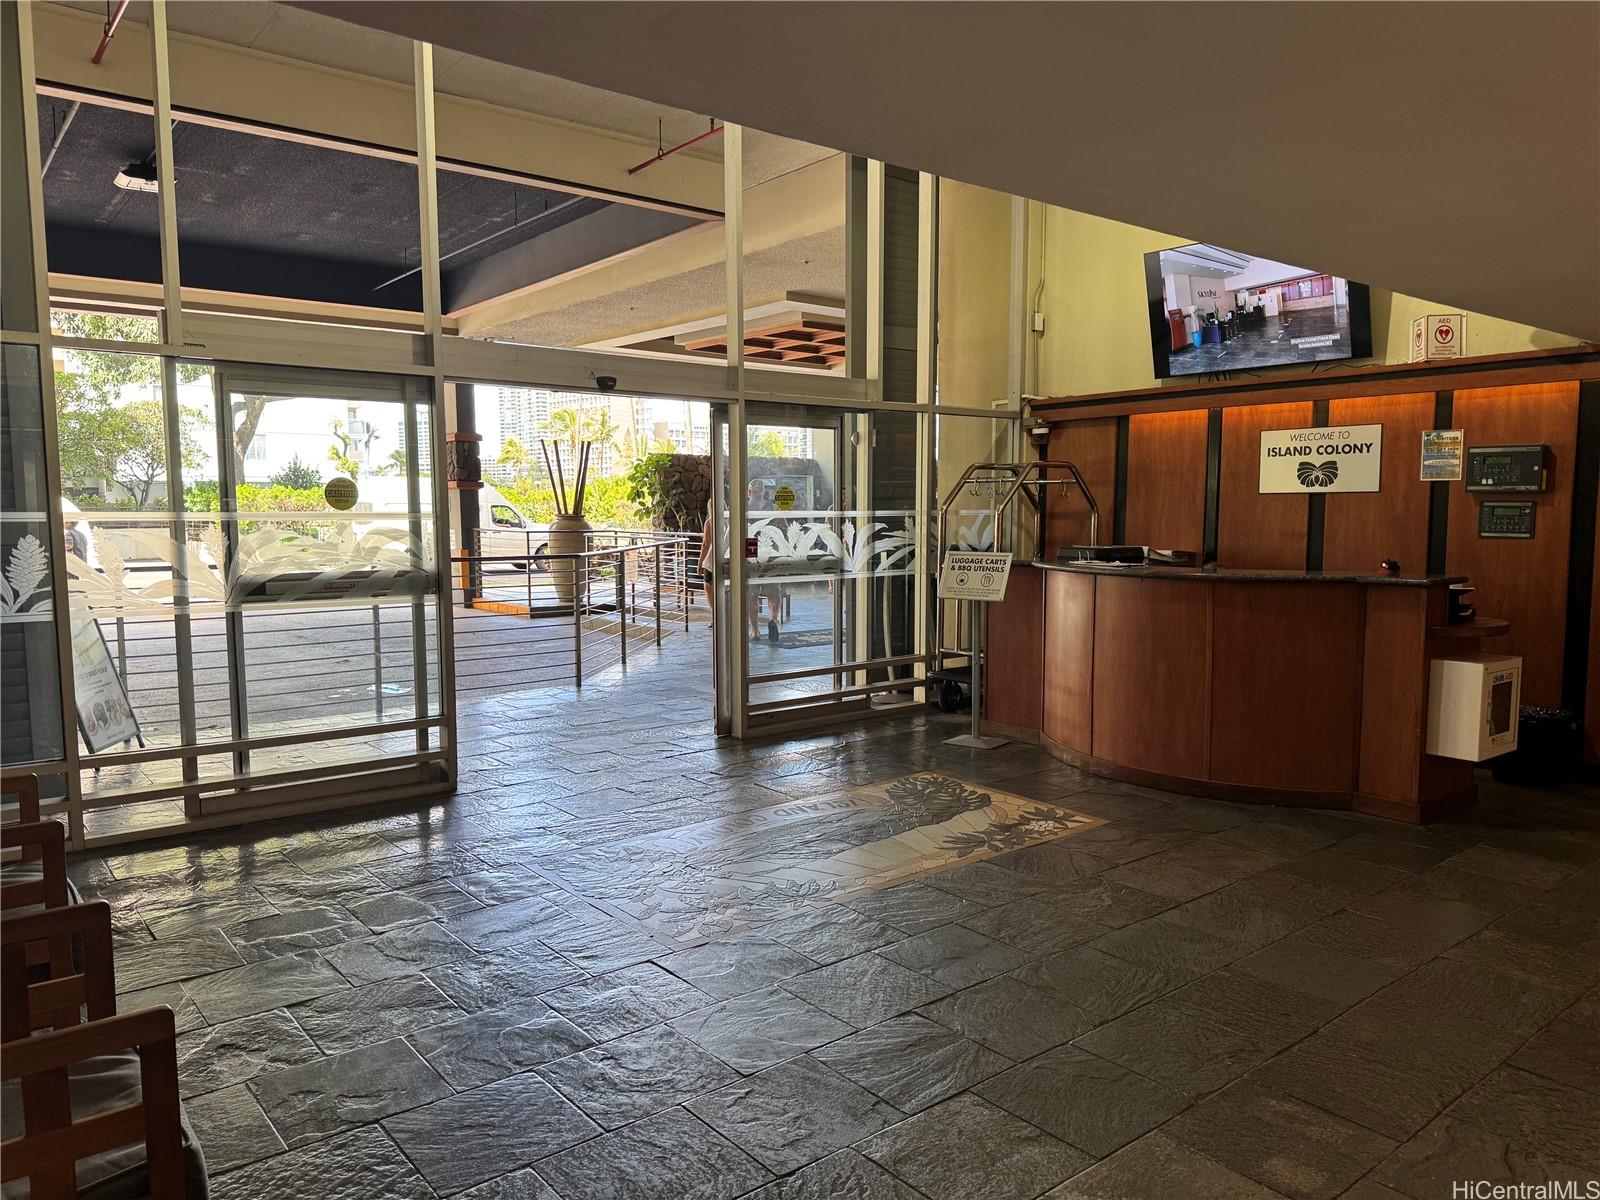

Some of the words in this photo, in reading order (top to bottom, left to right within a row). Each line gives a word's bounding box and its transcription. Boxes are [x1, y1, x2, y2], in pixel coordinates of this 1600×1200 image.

[1290, 431, 1335, 442] WELCOME
[1338, 430, 1351, 440] TO
[1267, 445, 1312, 458] ISLAND
[1316, 442, 1374, 456] COLONY
[326, 489, 358, 497] CAUTION
[951, 557, 983, 565] LUGGAGE
[985, 558, 1007, 566] CARTS
[973, 565, 1005, 573] UTENSILS
